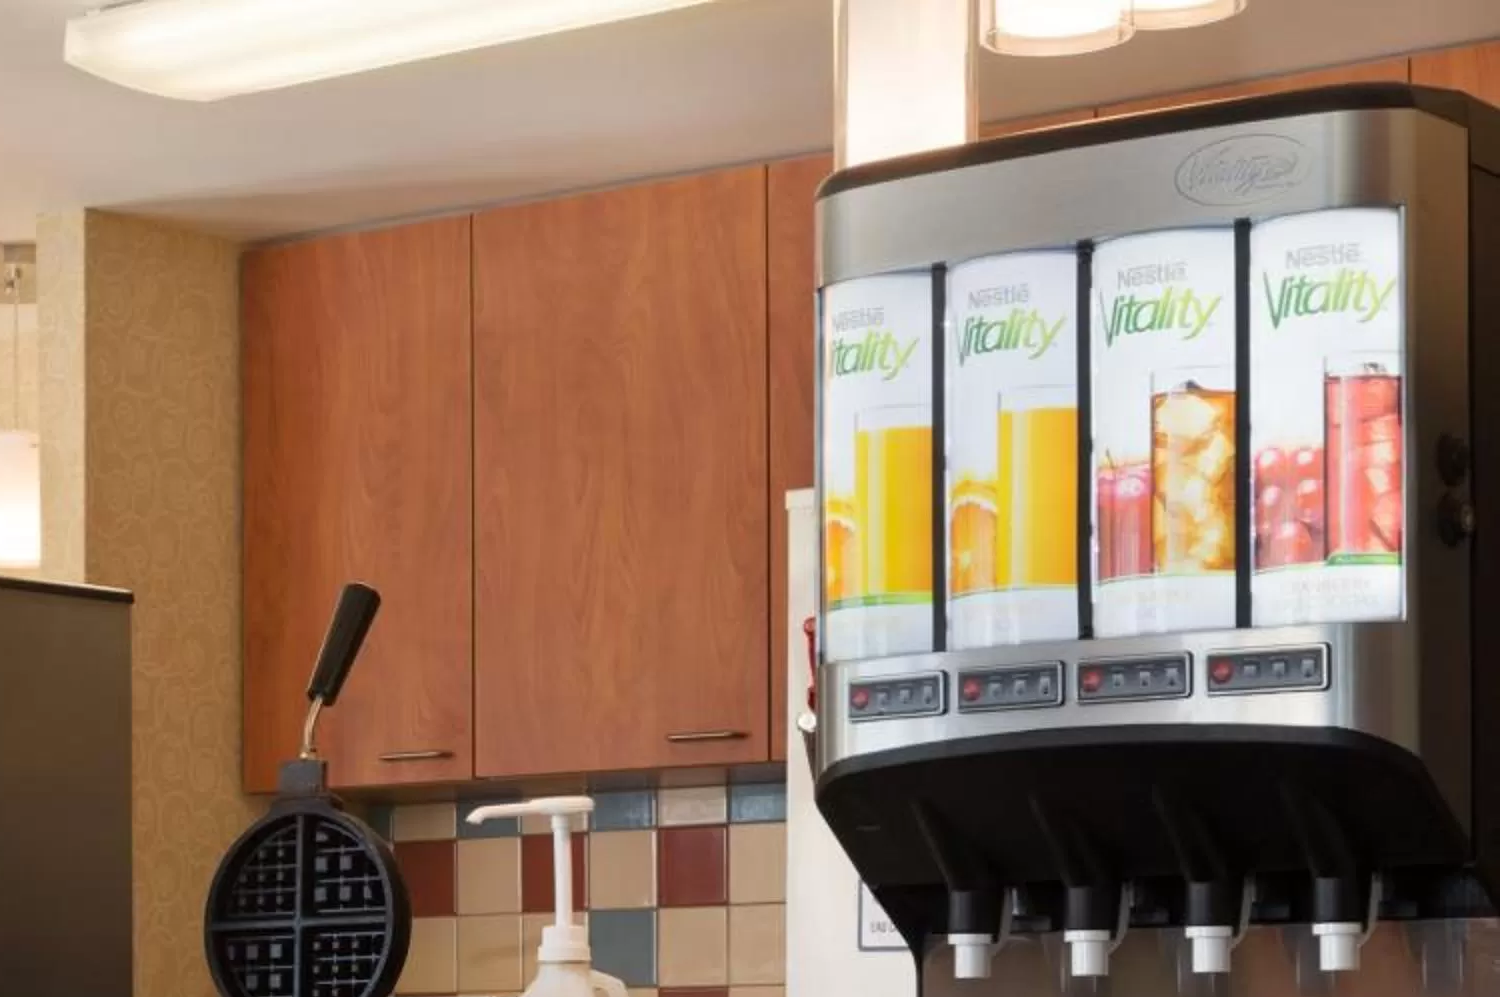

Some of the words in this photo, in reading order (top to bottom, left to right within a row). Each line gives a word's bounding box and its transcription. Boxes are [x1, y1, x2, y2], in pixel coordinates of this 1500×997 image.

[1099, 286, 1221, 348] Vitality
[1262, 267, 1396, 329] Vitality
[833, 330, 920, 381] tality
[956, 308, 1067, 367] Vitality
